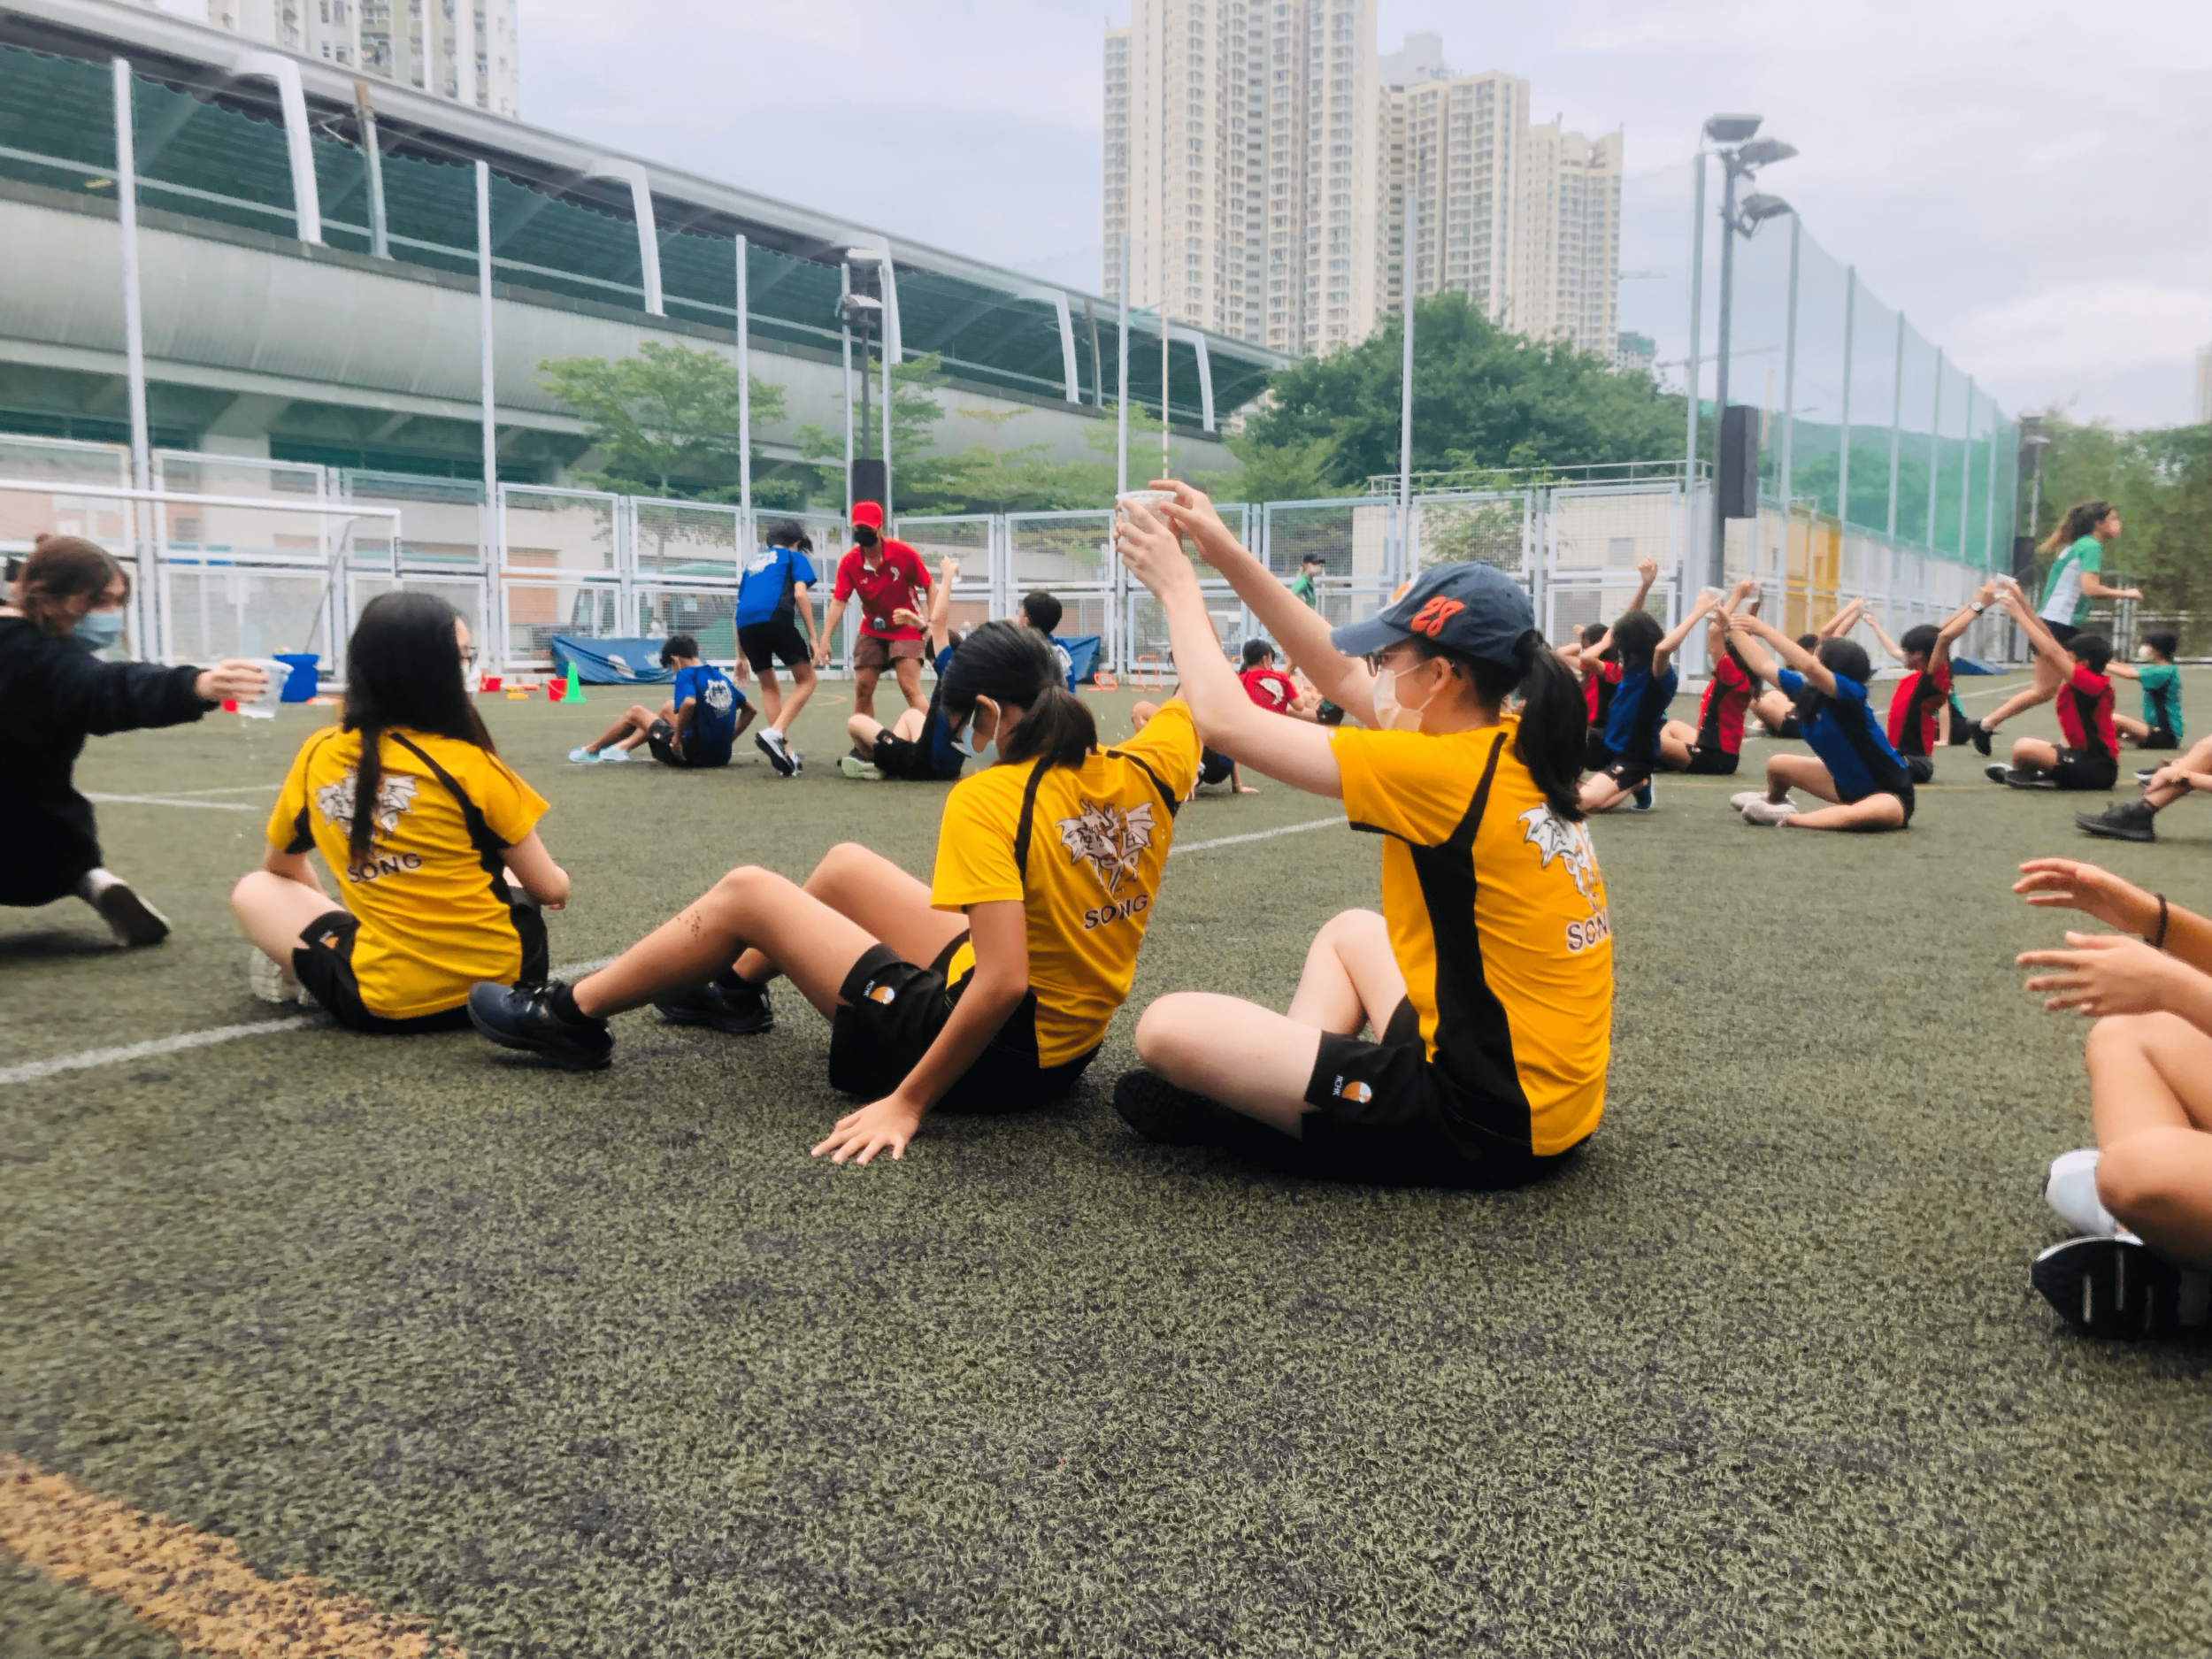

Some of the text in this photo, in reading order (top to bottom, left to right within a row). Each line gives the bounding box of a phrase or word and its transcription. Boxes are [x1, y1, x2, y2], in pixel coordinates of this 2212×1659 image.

[1410, 595, 1465, 637] 28
[347, 853, 422, 883] SONG
[1084, 894, 1149, 930] SONG
[1332, 1074, 1344, 1097] RCHK
